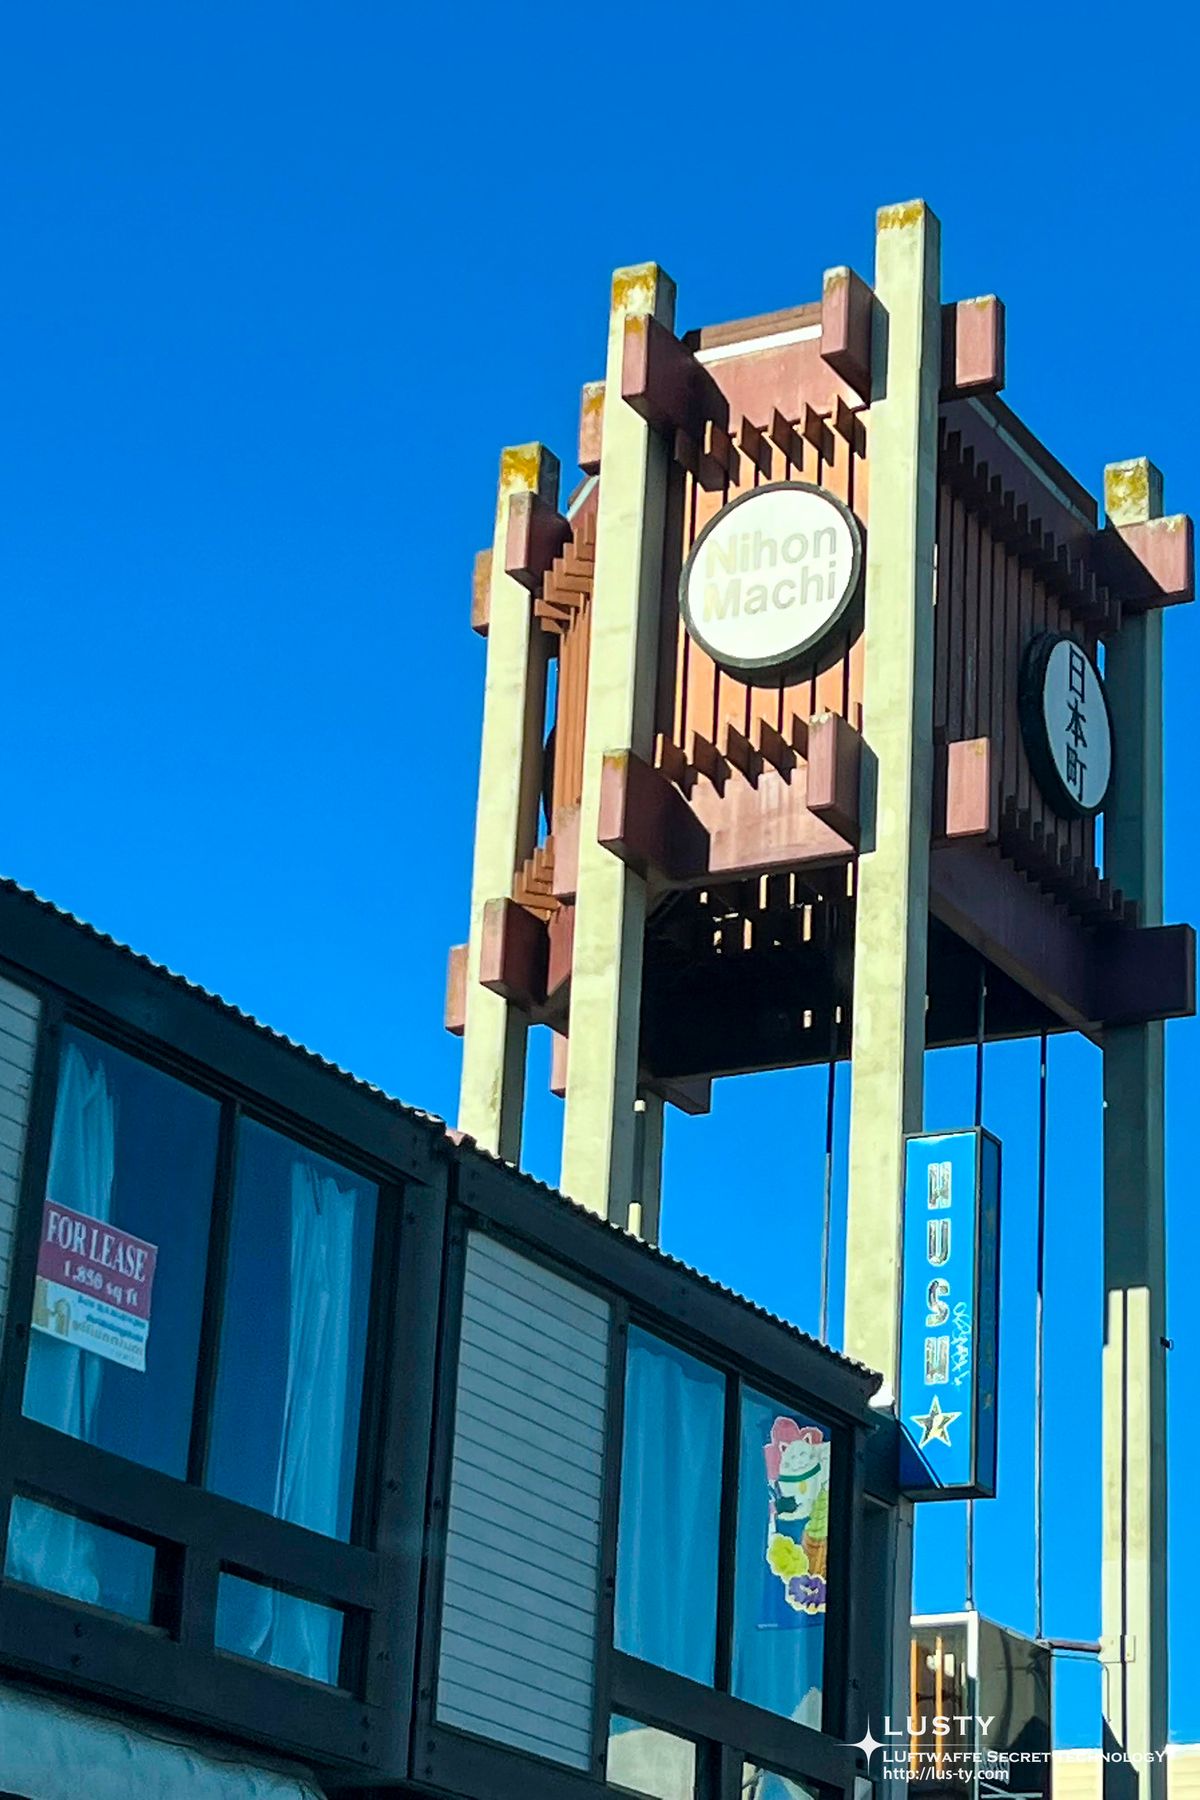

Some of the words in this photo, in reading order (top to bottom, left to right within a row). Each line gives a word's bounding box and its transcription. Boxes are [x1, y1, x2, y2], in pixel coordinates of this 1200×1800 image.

[705, 525, 838, 579] Nihon
[703, 561, 836, 623] Machi
[1065, 643, 1088, 801] 日本町
[46, 1210, 87, 1257] FOR
[89, 1229, 148, 1282] LEASE
